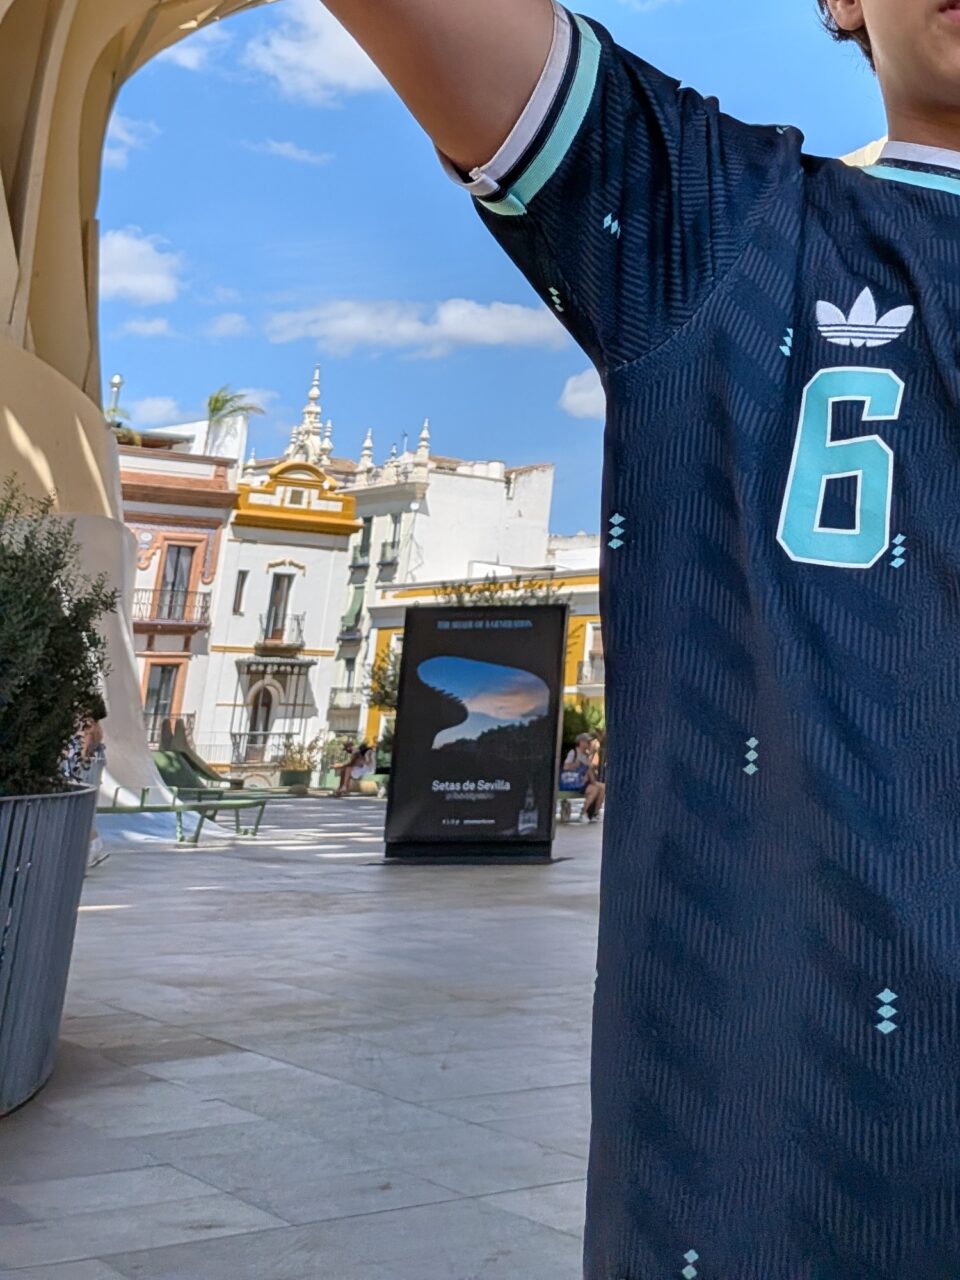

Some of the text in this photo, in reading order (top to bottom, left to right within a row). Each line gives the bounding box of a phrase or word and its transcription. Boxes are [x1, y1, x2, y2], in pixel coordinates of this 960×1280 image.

[774, 366, 906, 569] 6
[432, 780, 511, 792] Setas de Sevilla
